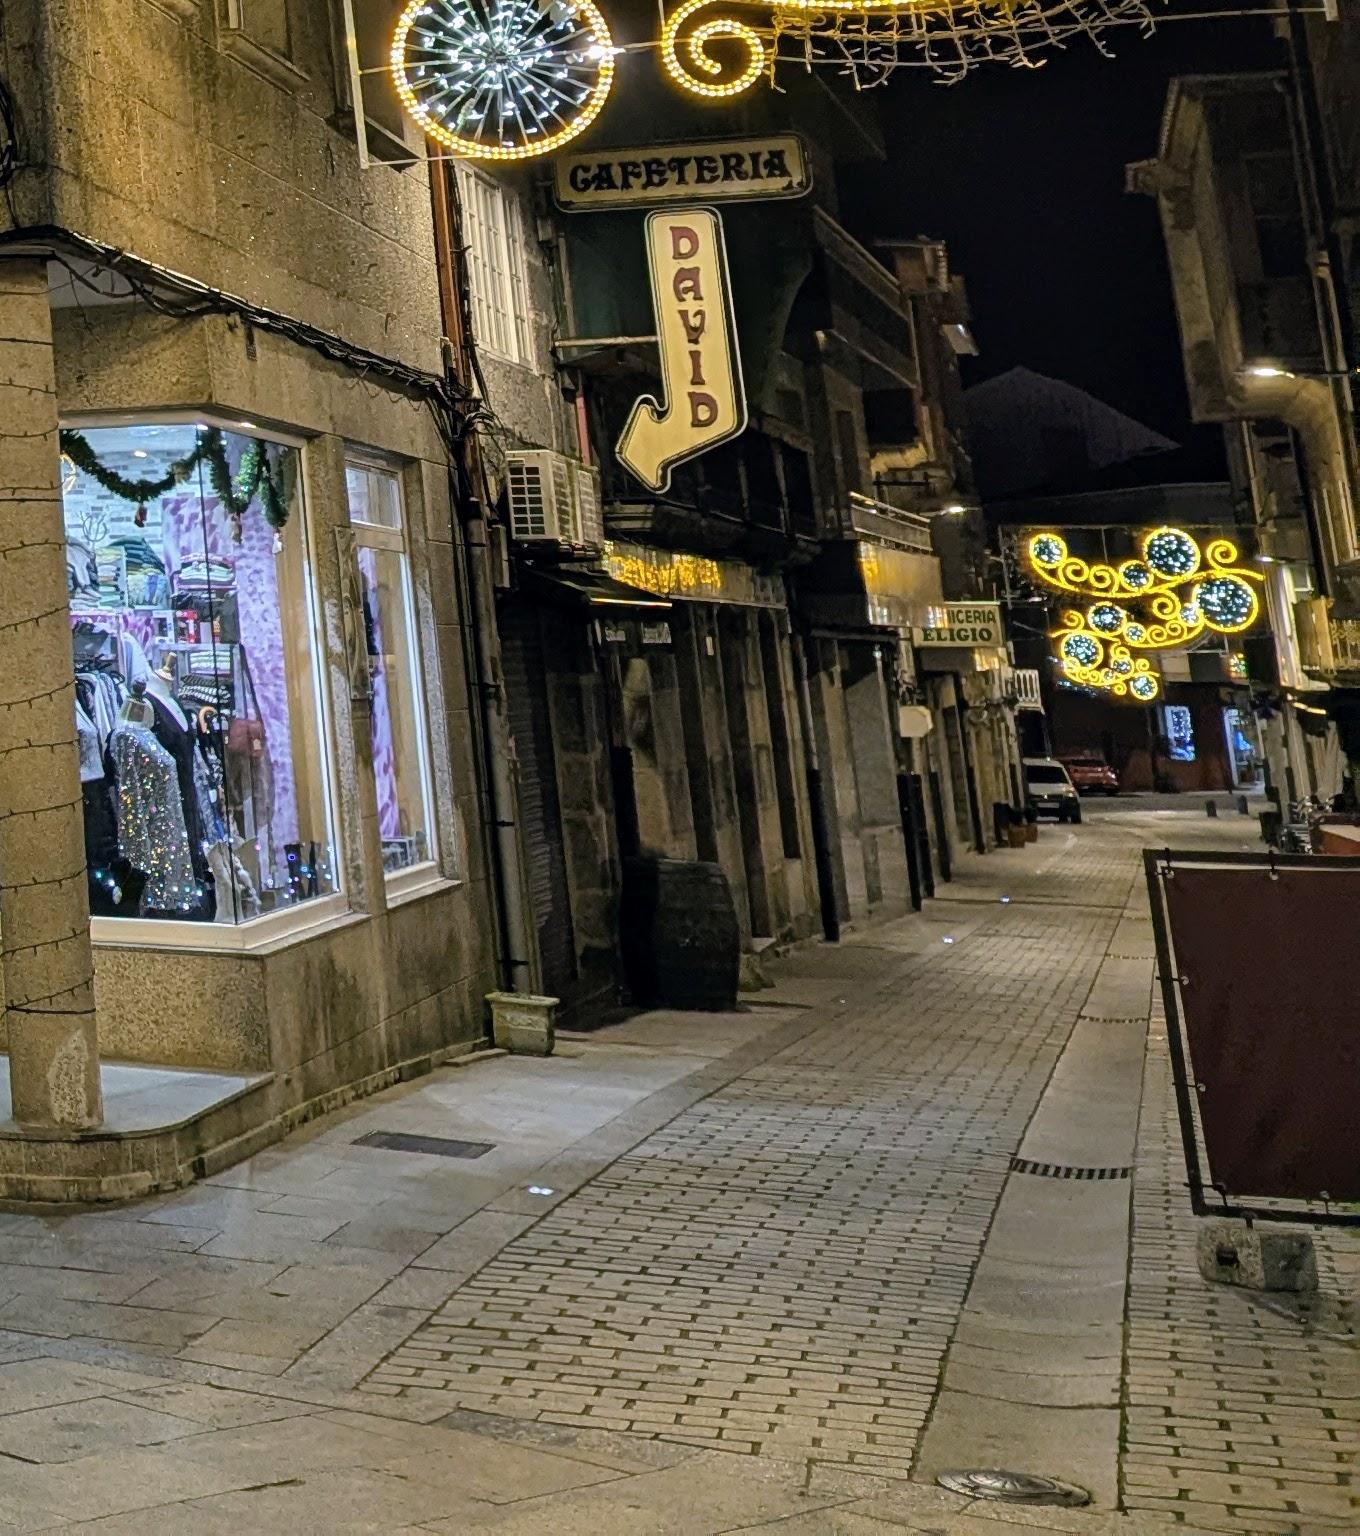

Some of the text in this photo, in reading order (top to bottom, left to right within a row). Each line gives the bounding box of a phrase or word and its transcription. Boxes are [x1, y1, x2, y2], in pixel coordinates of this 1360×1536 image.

[569, 149, 792, 192] CAFETERIA
[669, 225, 718, 428] DAVID
[923, 627, 993, 642] ELIGIO
